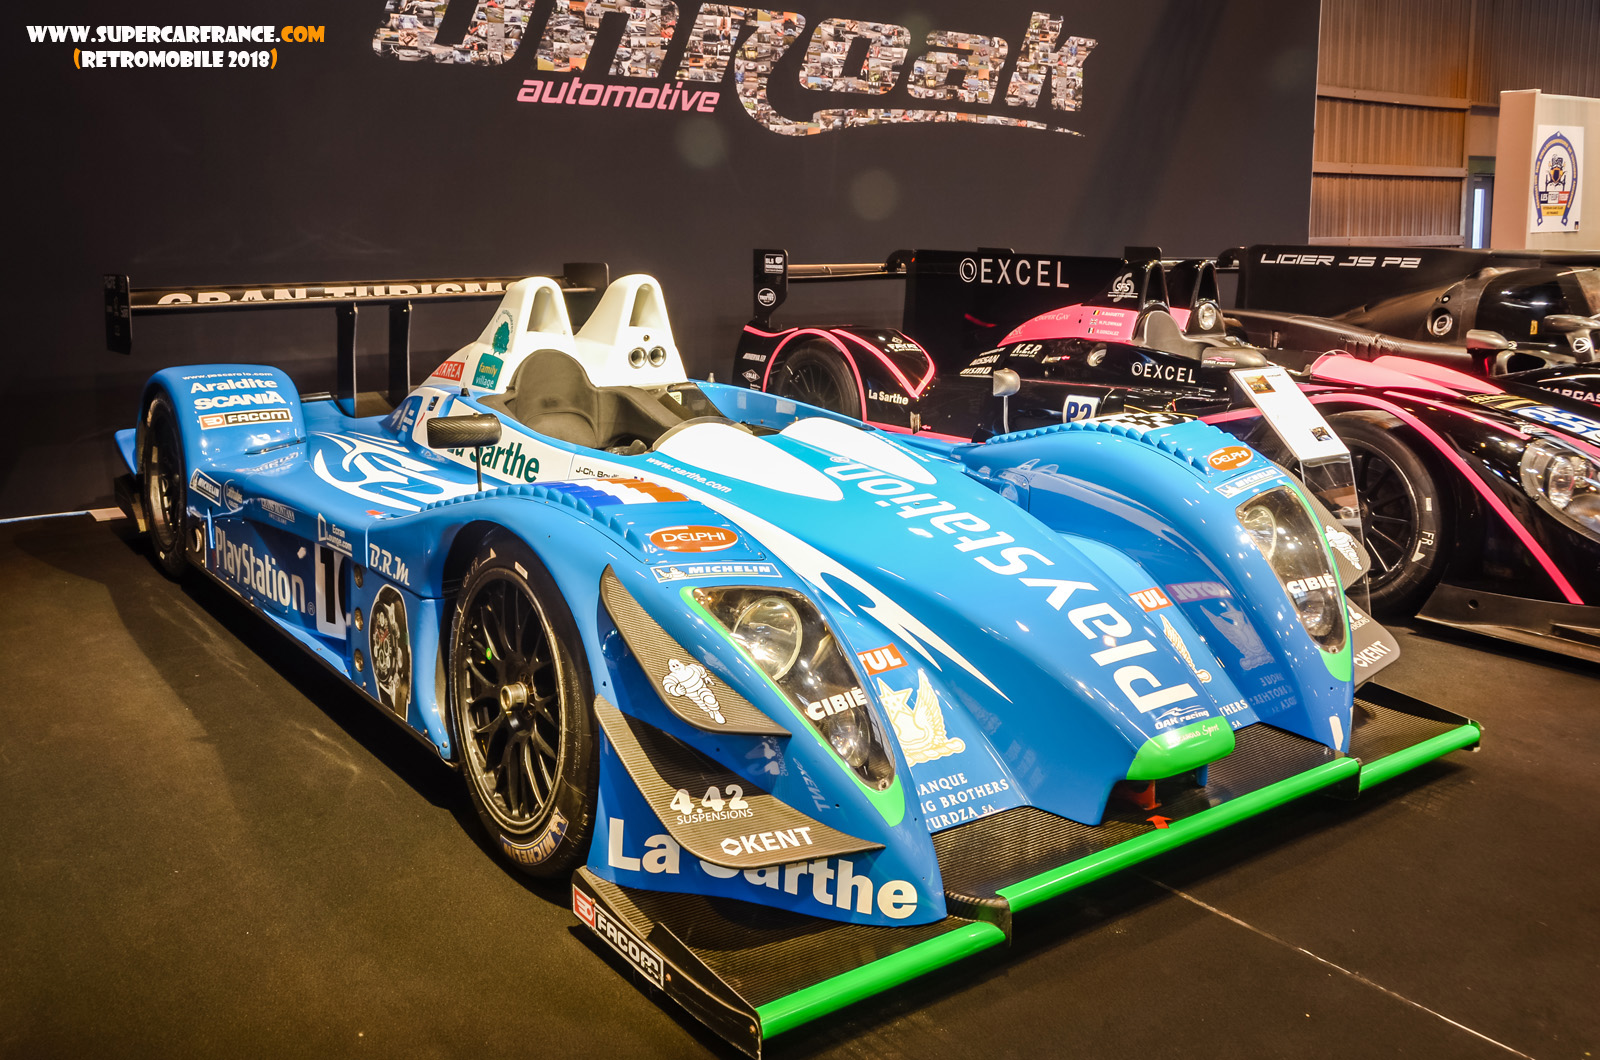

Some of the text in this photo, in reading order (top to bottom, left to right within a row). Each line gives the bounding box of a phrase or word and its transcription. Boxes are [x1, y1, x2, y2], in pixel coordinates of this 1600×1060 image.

[516, 77, 721, 113] automotive
[1260, 253, 1422, 269] LIGIER JS P2
[980, 257, 1070, 289] EXCEL
[478, 361, 498, 377] family
[968, 354, 1001, 367] NISSAN
[182, 371, 273, 381] www.pescarolo.com
[475, 374, 495, 389] village
[1143, 363, 1197, 384] EXCEL
[190, 379, 278, 394] Araldite
[193, 391, 287, 411] SCANIA
[868, 389, 909, 406] La Sarthe
[227, 410, 288, 425] FACOM
[1066, 401, 1092, 423] P2
[1212, 450, 1247, 466] DELPHI
[645, 457, 733, 494] www.sarthe.com
[661, 530, 727, 543] DELPHI
[688, 564, 771, 575] MICHELIN
[1356, 641, 1392, 665] KENT
[806, 686, 868, 721] CIBIÉ
[1154, 709, 1210, 730] OAK racing
[1231, 720, 1243, 729] SA
[669, 784, 749, 816] 4.42
[939, 778, 1009, 810] BROTHERS
[676, 808, 754, 825] SUSPENSIONS
[981, 803, 995, 814] SA
[608, 817, 680, 875] La
[739, 826, 812, 854] KENT
[597, 914, 661, 980] FACOM
